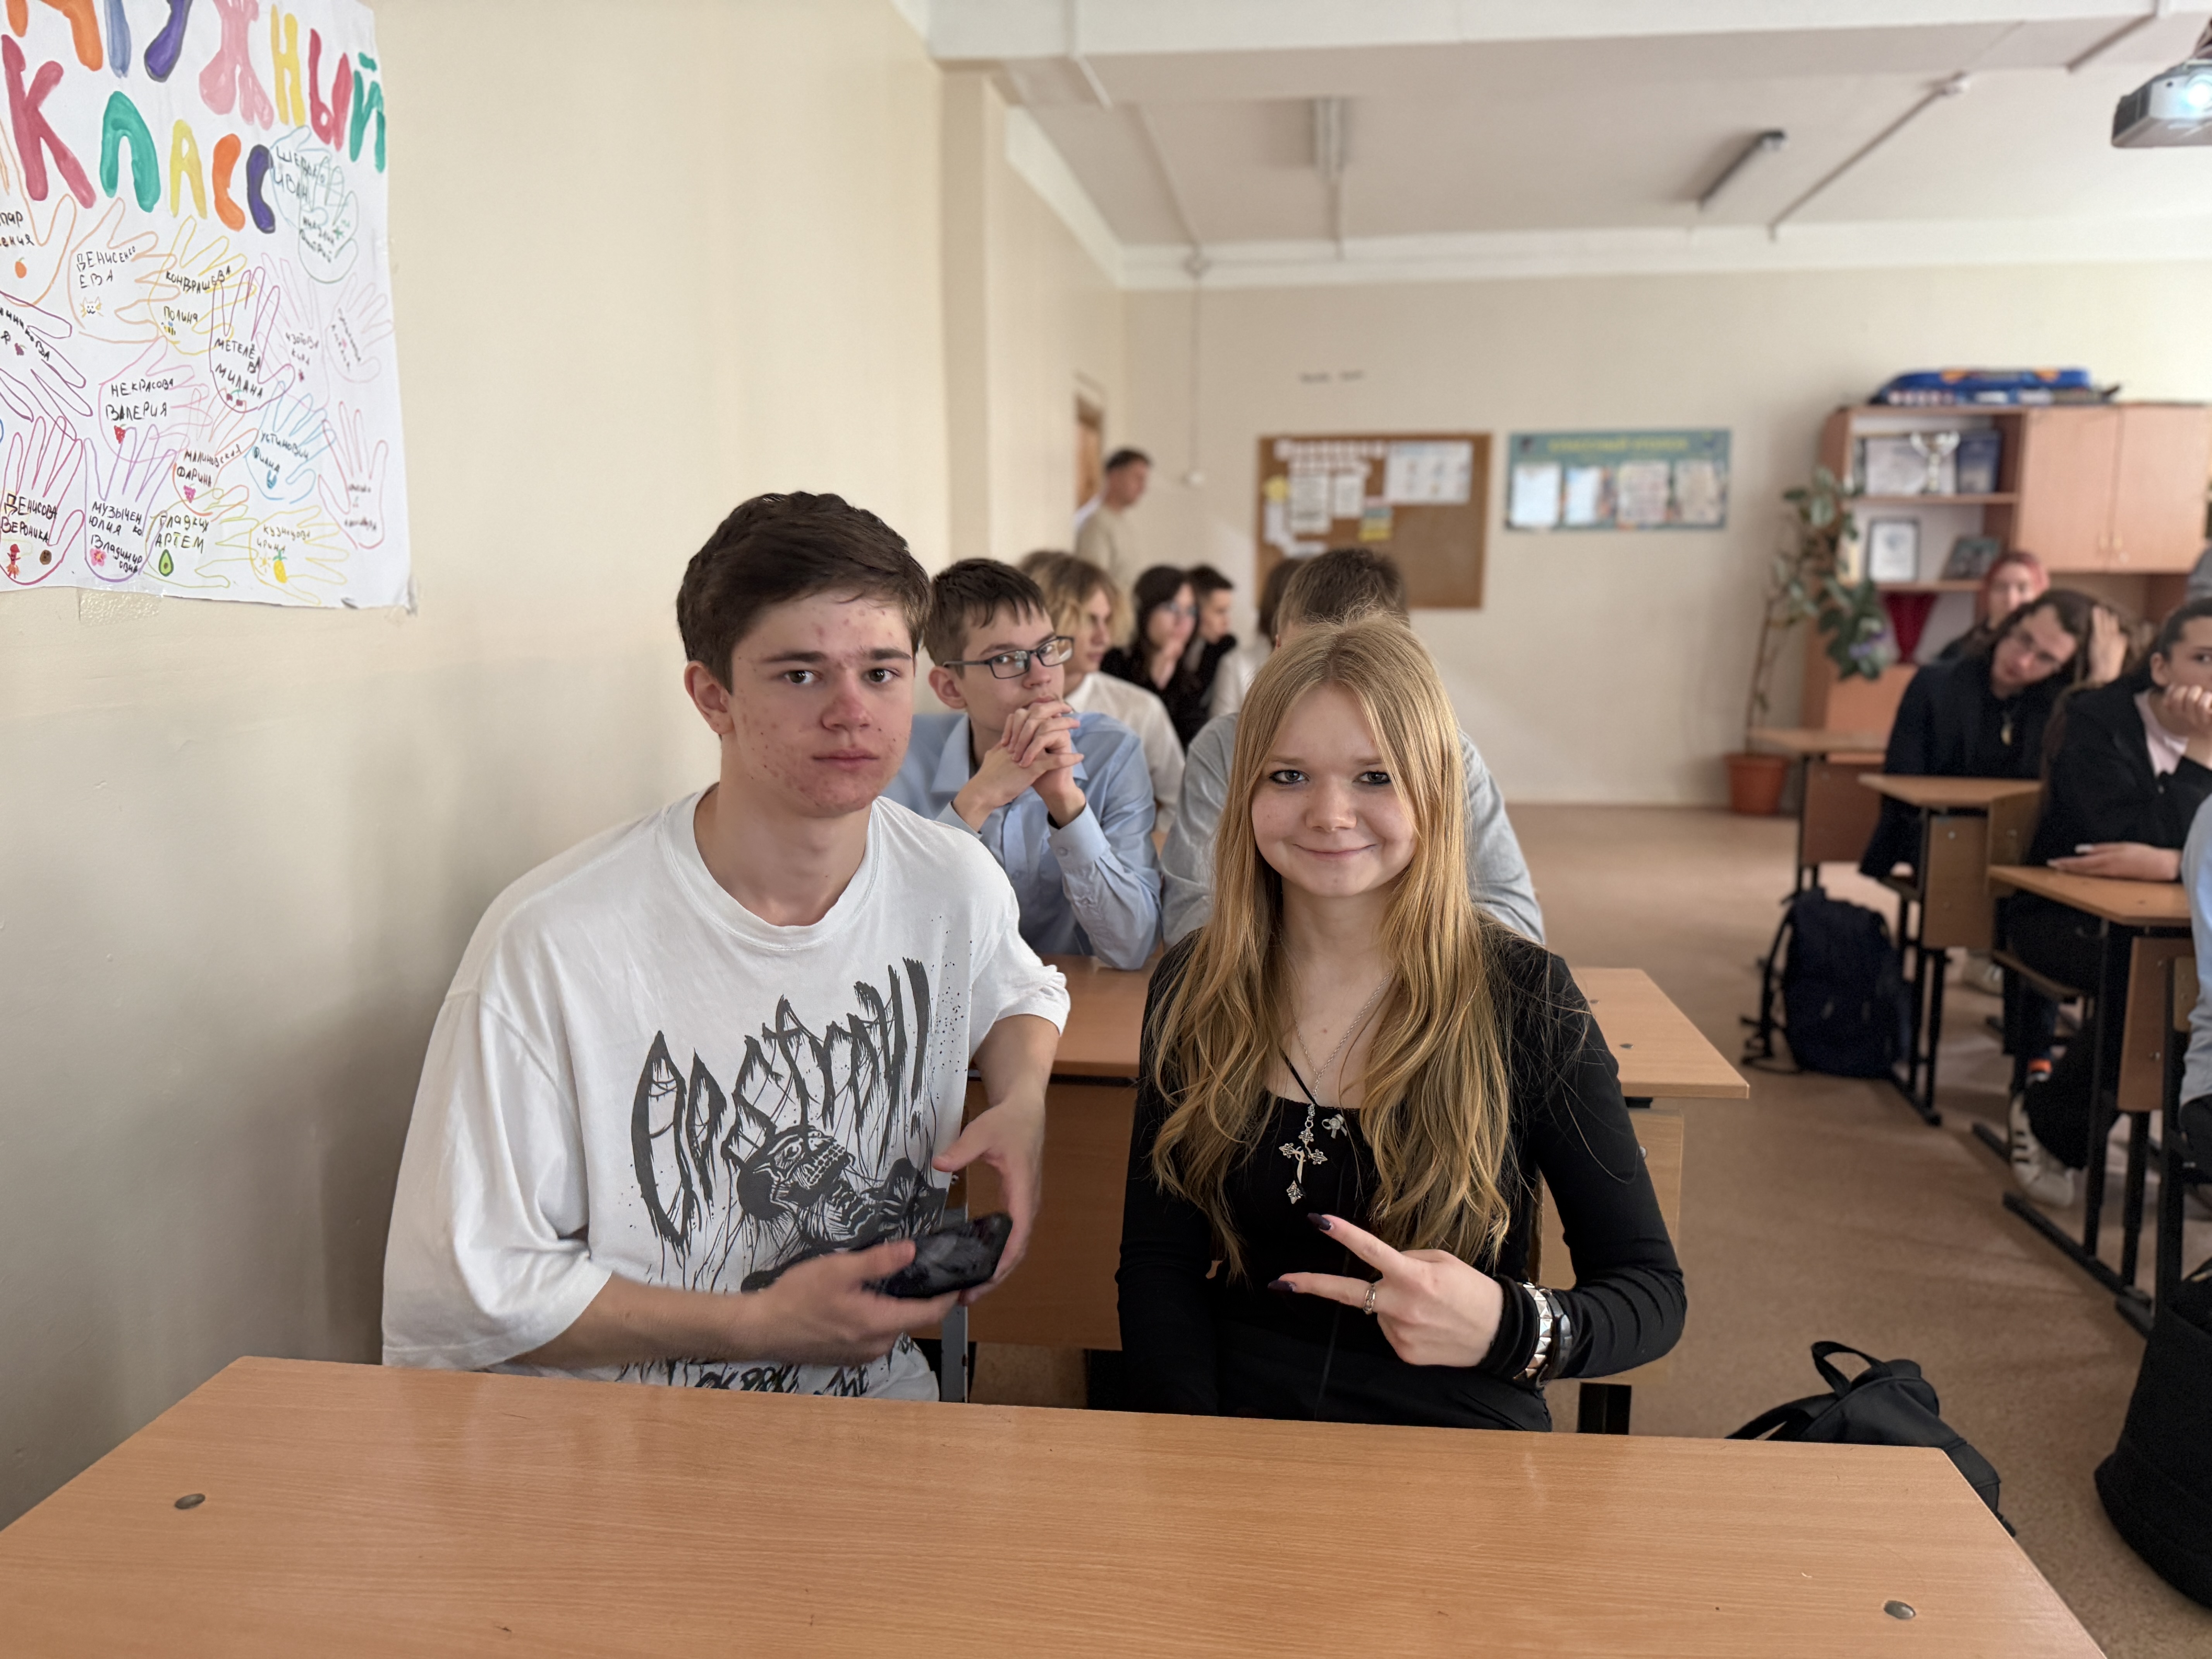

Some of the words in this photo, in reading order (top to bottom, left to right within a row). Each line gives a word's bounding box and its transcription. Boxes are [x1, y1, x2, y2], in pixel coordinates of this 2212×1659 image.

[2, 34, 275, 234] КЛАСС
[0, 234, 35, 247] ения
[80, 269, 113, 289] ЕВА
[111, 378, 173, 397] НЕКРАСОВА
[215, 363, 263, 399] МИЛАНА
[105, 401, 167, 421] ВАЛЕРИЯ
[184, 443, 241, 468] МАЛИНОВСКАЯ
[4, 493, 57, 520] ДЕНИСОВА
[1, 516, 49, 543] ВЕРОНИКА
[89, 515, 122, 536] ЮЛИЯ
[155, 532, 204, 554] АРТЕМ
